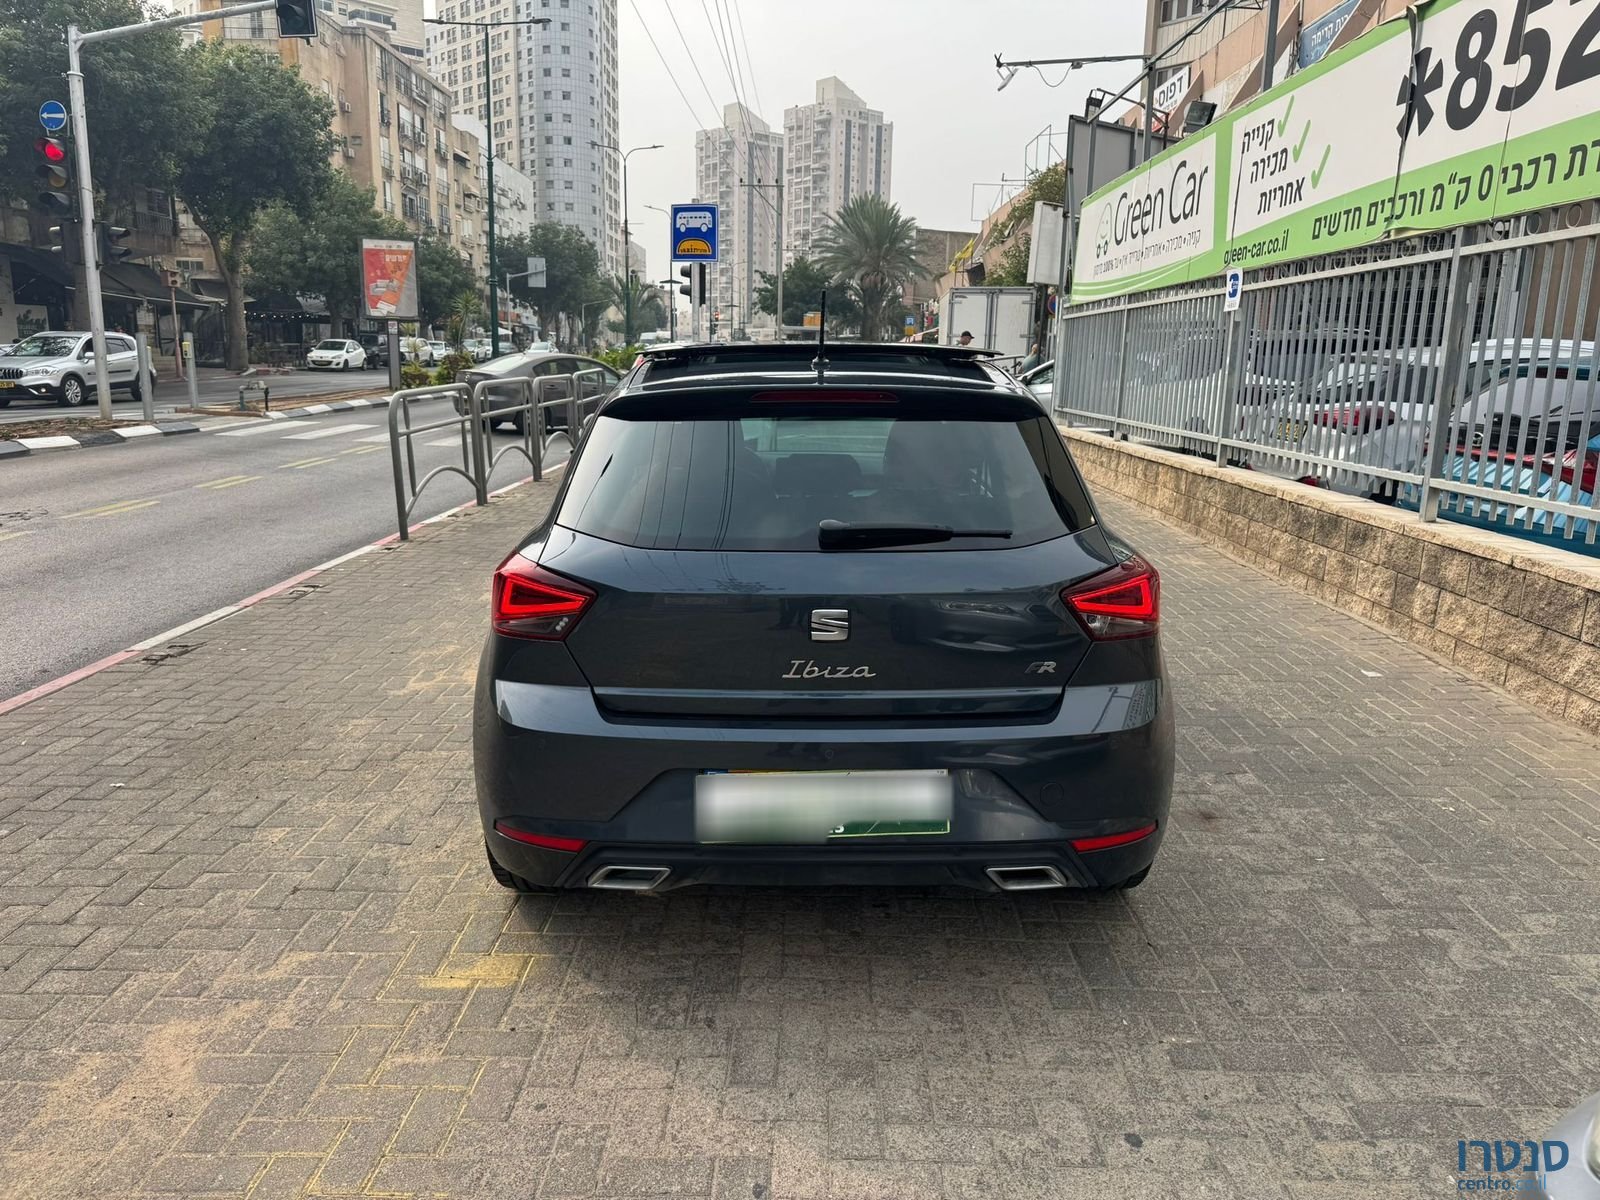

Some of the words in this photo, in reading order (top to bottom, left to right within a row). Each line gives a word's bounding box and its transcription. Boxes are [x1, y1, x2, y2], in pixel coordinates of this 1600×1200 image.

[1159, 75, 1184, 107] דפוס
[1242, 118, 1275, 154] קנייה
[1250, 148, 1289, 184] מכירה
[1477, 164, 1494, 201] 0
[1502, 152, 1556, 195] רכבי
[1114, 187, 1165, 246] Green
[1169, 160, 1209, 225] Car
[1257, 177, 1305, 215] אחריות
[1366, 188, 1425, 227] ורכבים
[1311, 206, 1362, 240] חדשים
[782, 659, 877, 679] Ibiza
[1024, 661, 1057, 674] FR
